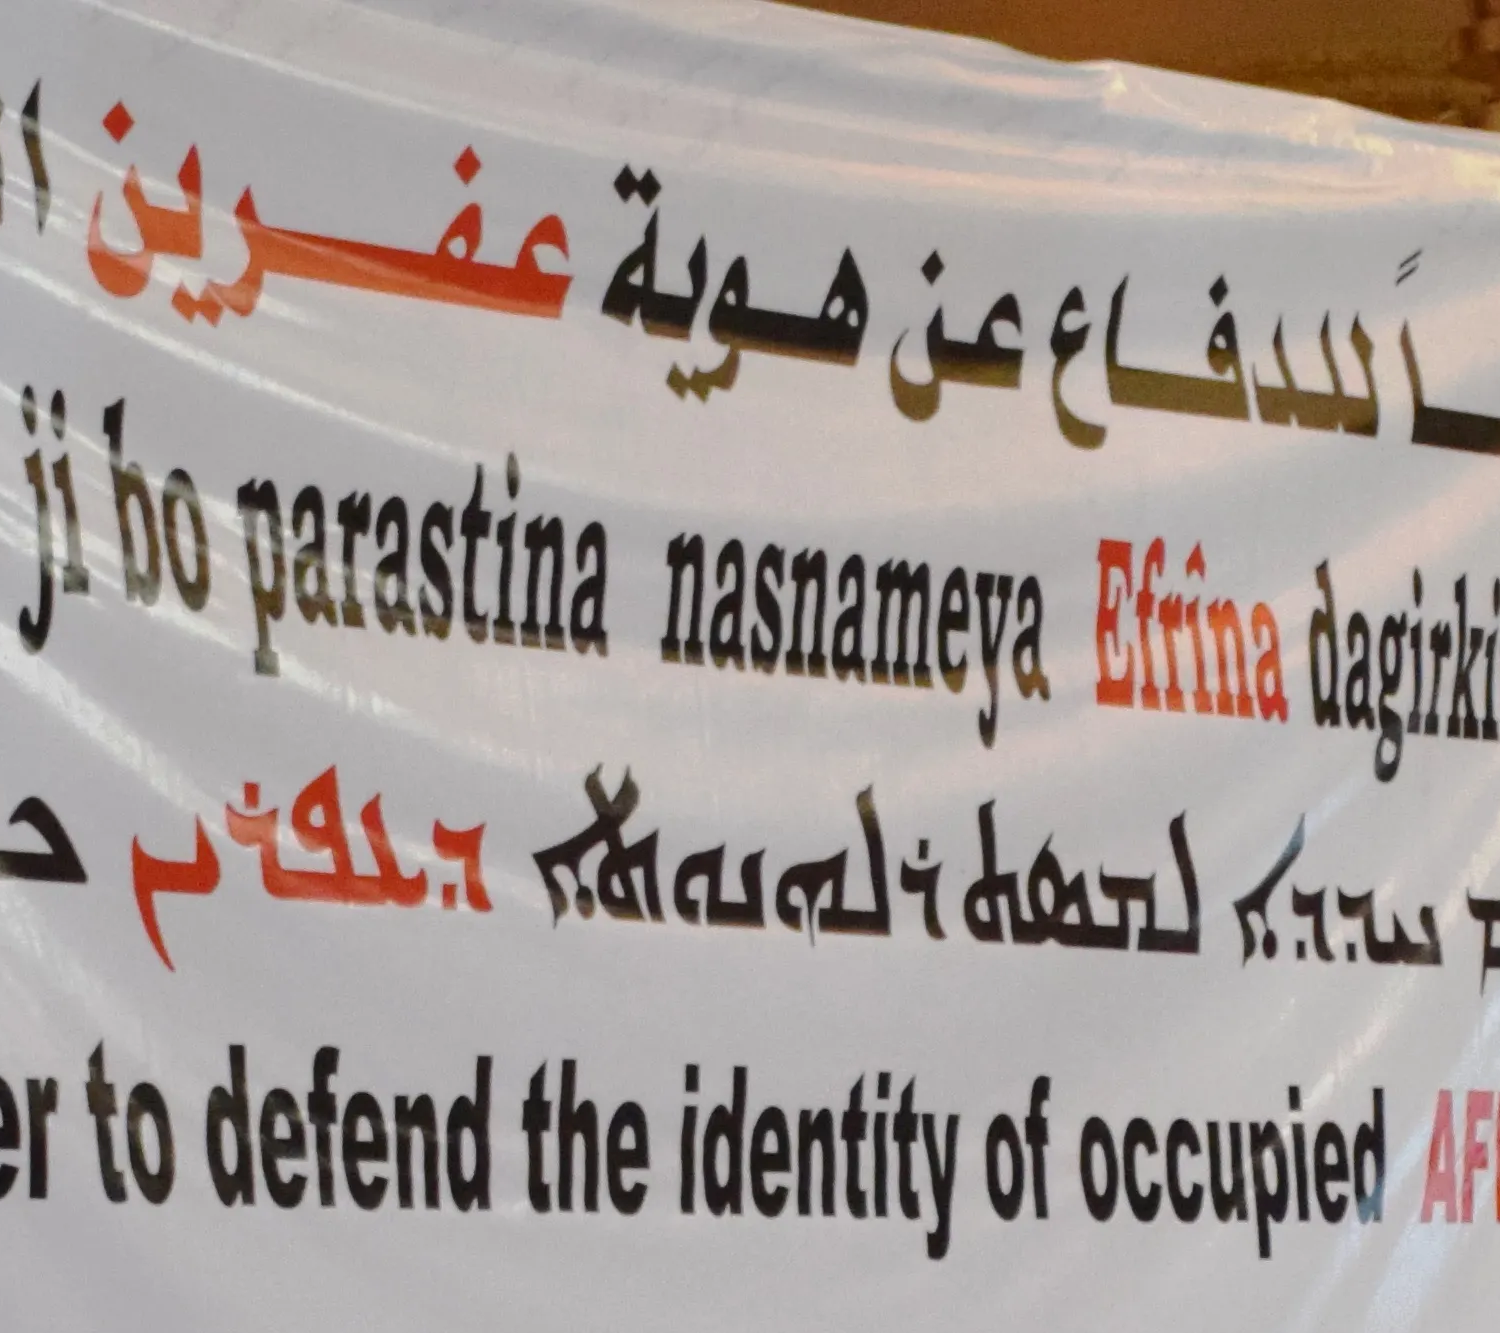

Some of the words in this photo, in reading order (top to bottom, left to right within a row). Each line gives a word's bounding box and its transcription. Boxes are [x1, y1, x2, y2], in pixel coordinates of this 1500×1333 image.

[86, 100, 573, 326] عفرين
[600, 164, 869, 403] هوية
[890, 249, 1023, 422] عن
[1051, 272, 1379, 452] للدفاع
[17, 383, 91, 655] ji
[101, 397, 211, 613] bo
[236, 452, 609, 678] parastina
[660, 529, 1051, 749] nasnameya
[1095, 534, 1289, 725] Efrîna
[86, 1036, 176, 1205] to
[204, 1042, 492, 1212] defend
[520, 1057, 651, 1215] the
[679, 1061, 958, 1261] identity
[984, 1074, 1051, 1222] of
[1078, 1084, 1385, 1258] occupied
